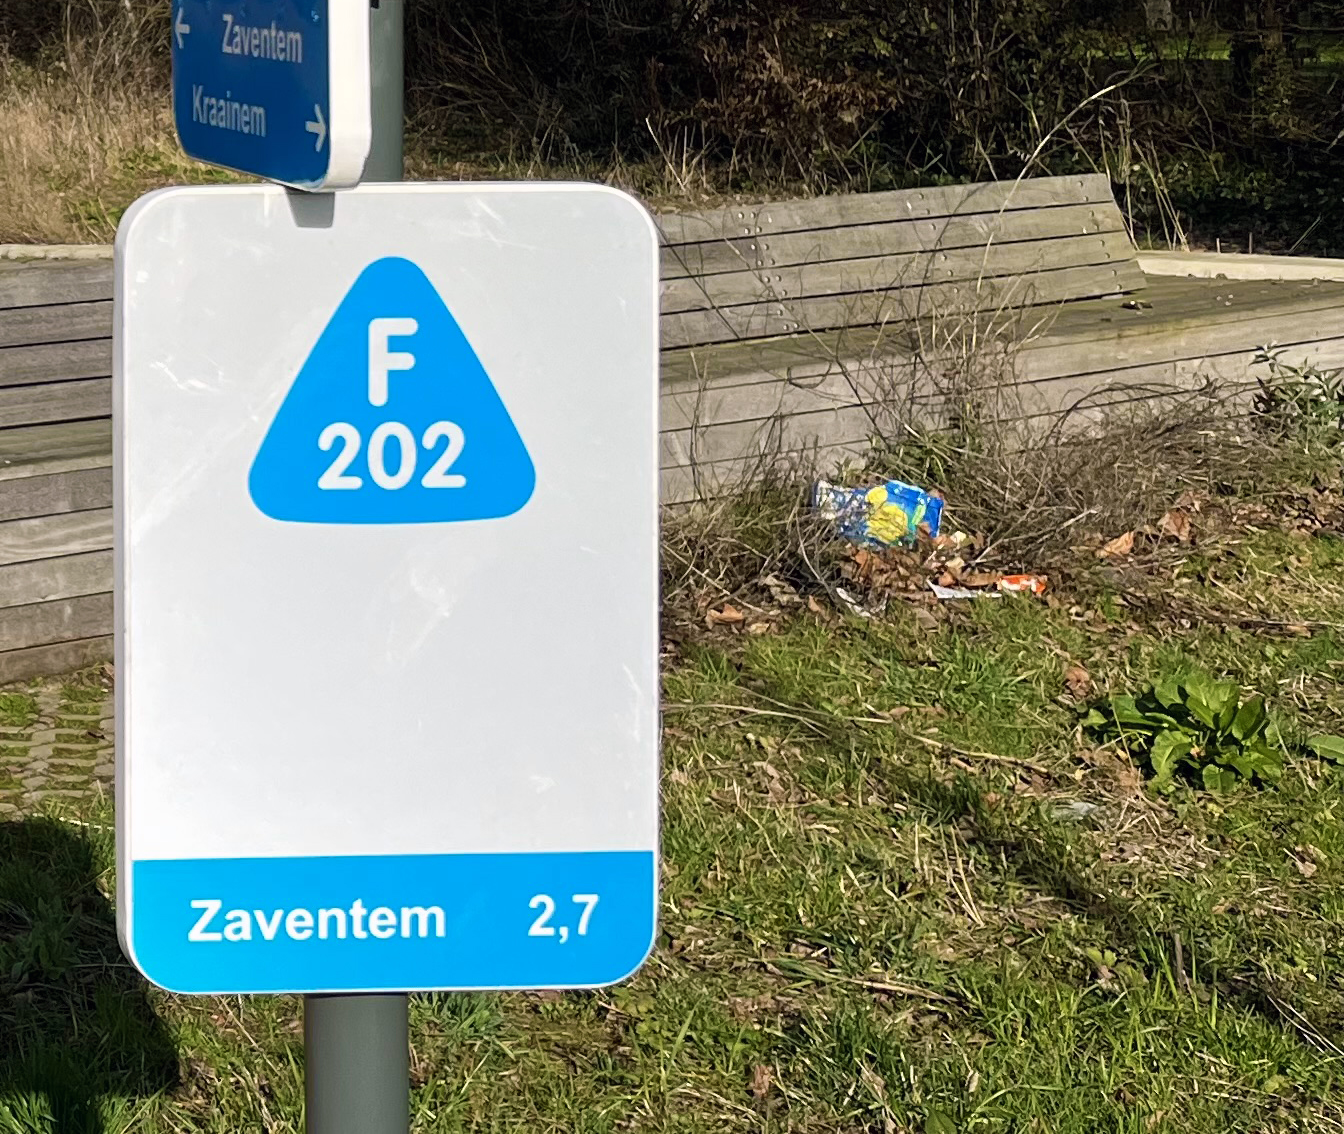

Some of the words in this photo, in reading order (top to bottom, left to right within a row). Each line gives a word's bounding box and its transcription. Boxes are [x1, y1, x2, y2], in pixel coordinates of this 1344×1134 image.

[221, 13, 303, 64] Zaventem
[192, 84, 267, 138] Kraainem
[367, 316, 419, 407] F
[316, 421, 467, 492] 202
[187, 899, 445, 943] Zaventem
[527, 893, 600, 945] 2,7
